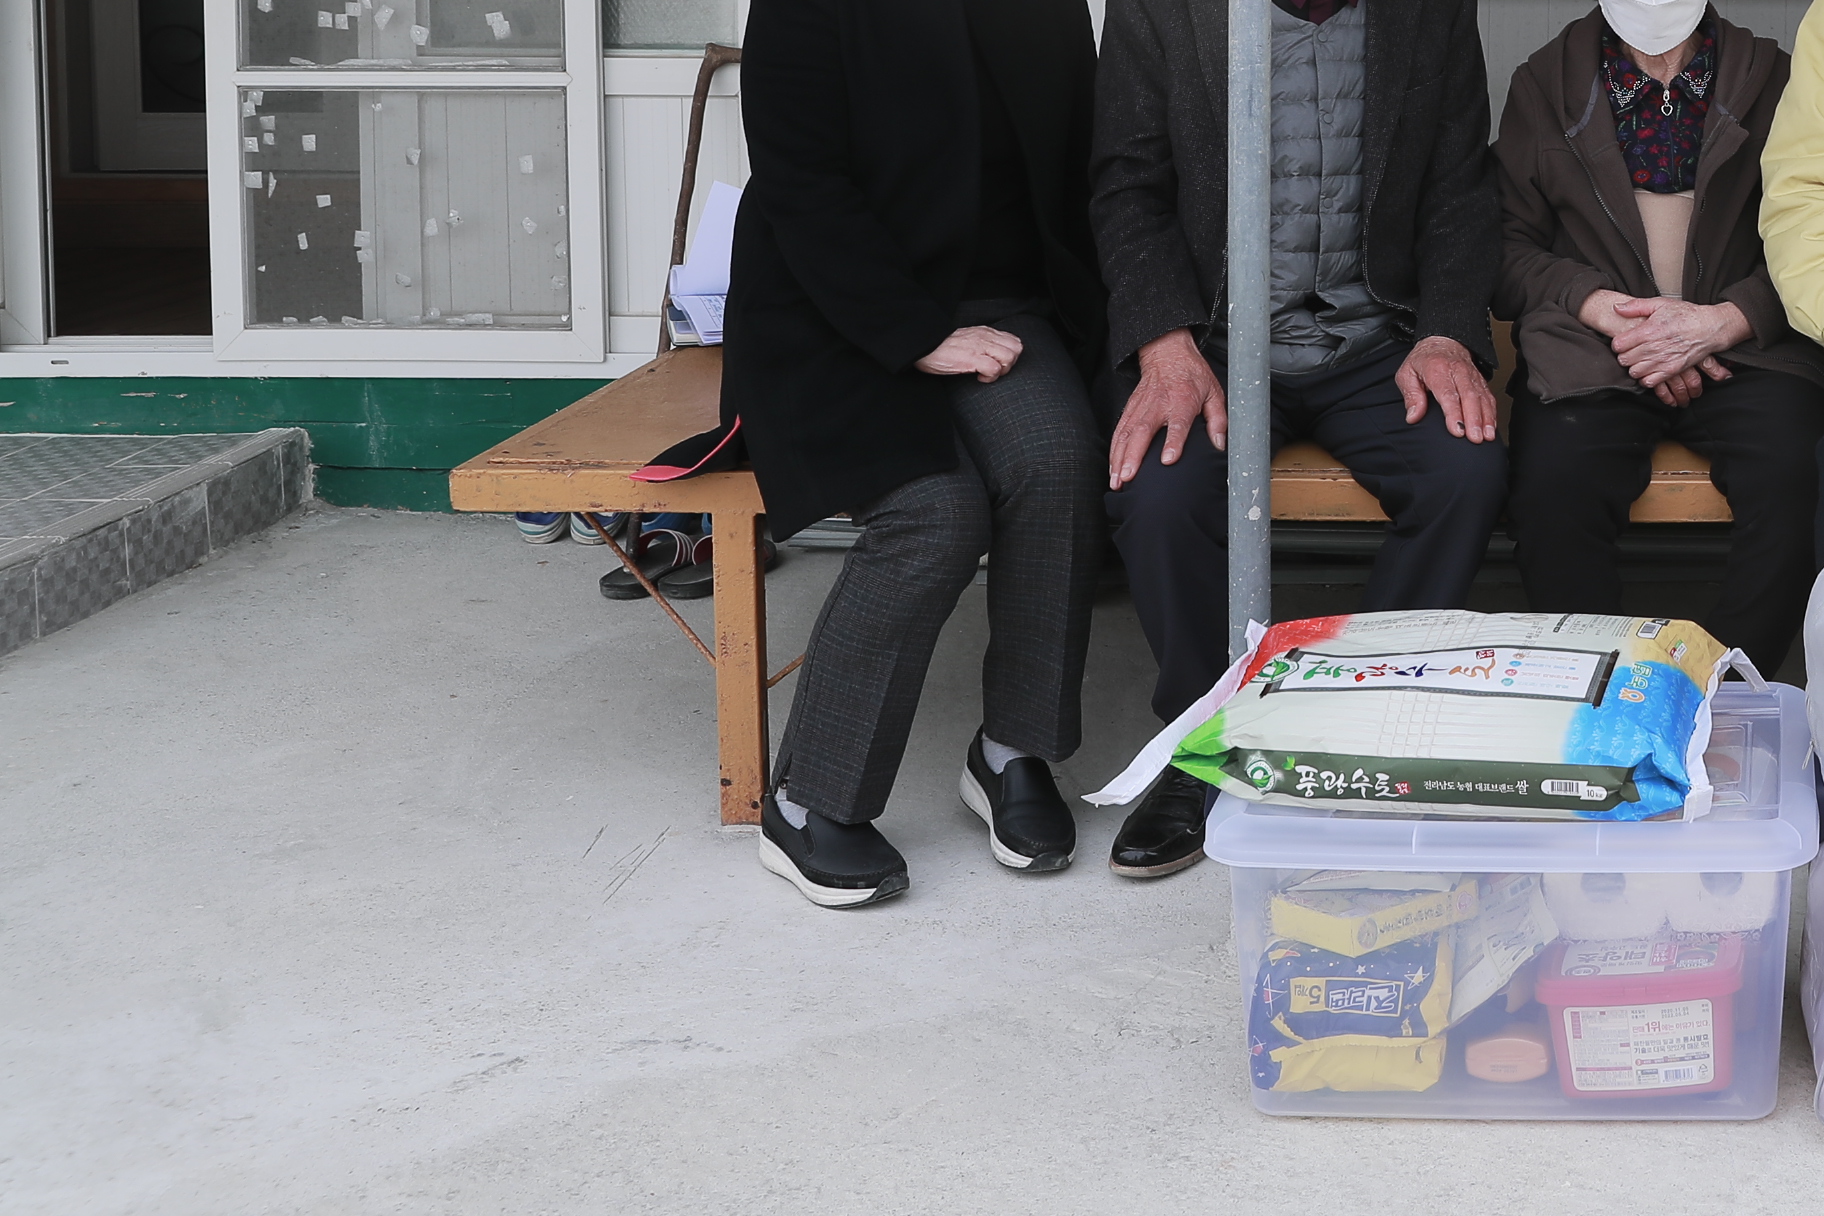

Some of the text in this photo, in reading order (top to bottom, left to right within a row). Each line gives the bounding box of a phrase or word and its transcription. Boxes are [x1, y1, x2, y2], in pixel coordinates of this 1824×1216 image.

[1294, 765, 1400, 798] 풍광수토
[1475, 781, 1515, 794] 대표브랜드
[1515, 779, 1530, 796] 쌀
[1577, 950, 1647, 964] 태양초
[1294, 983, 1397, 1013] 진라면 5개입
